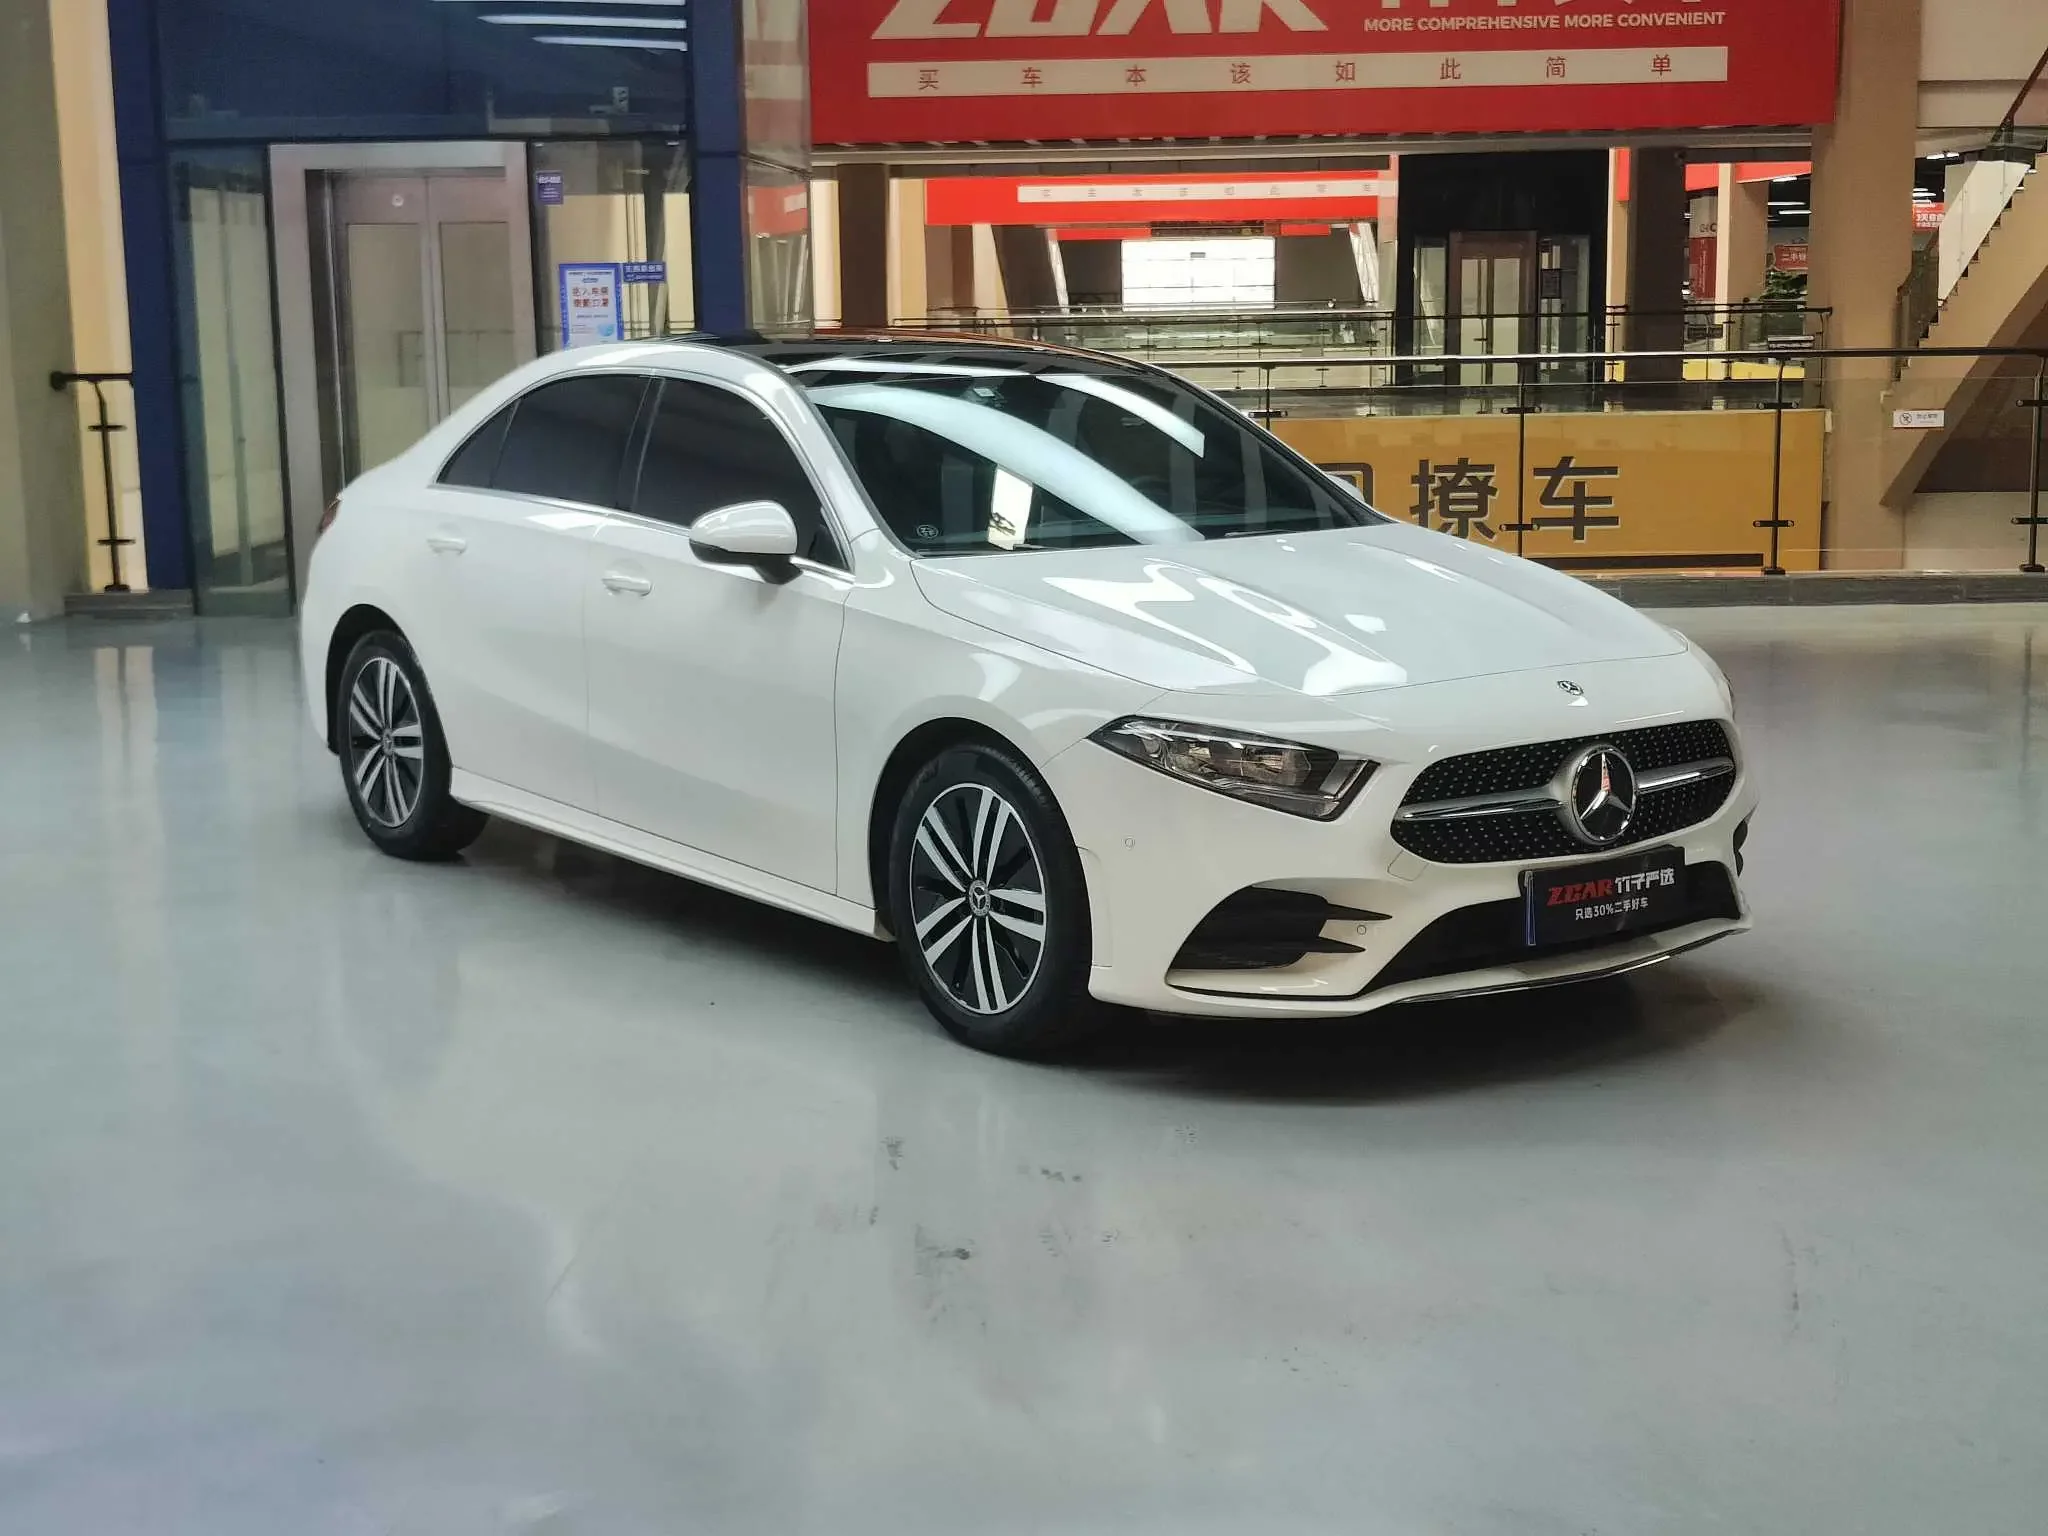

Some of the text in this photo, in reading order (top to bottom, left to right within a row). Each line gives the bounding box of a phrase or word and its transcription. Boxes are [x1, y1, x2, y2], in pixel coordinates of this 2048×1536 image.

[1363, 11, 1726, 32] MORE COMPREHENSIVE MORE CONVENIENT
[918, 54, 1672, 91] 买车本该如此简单
[1614, 867, 1675, 894] 竹子严选
